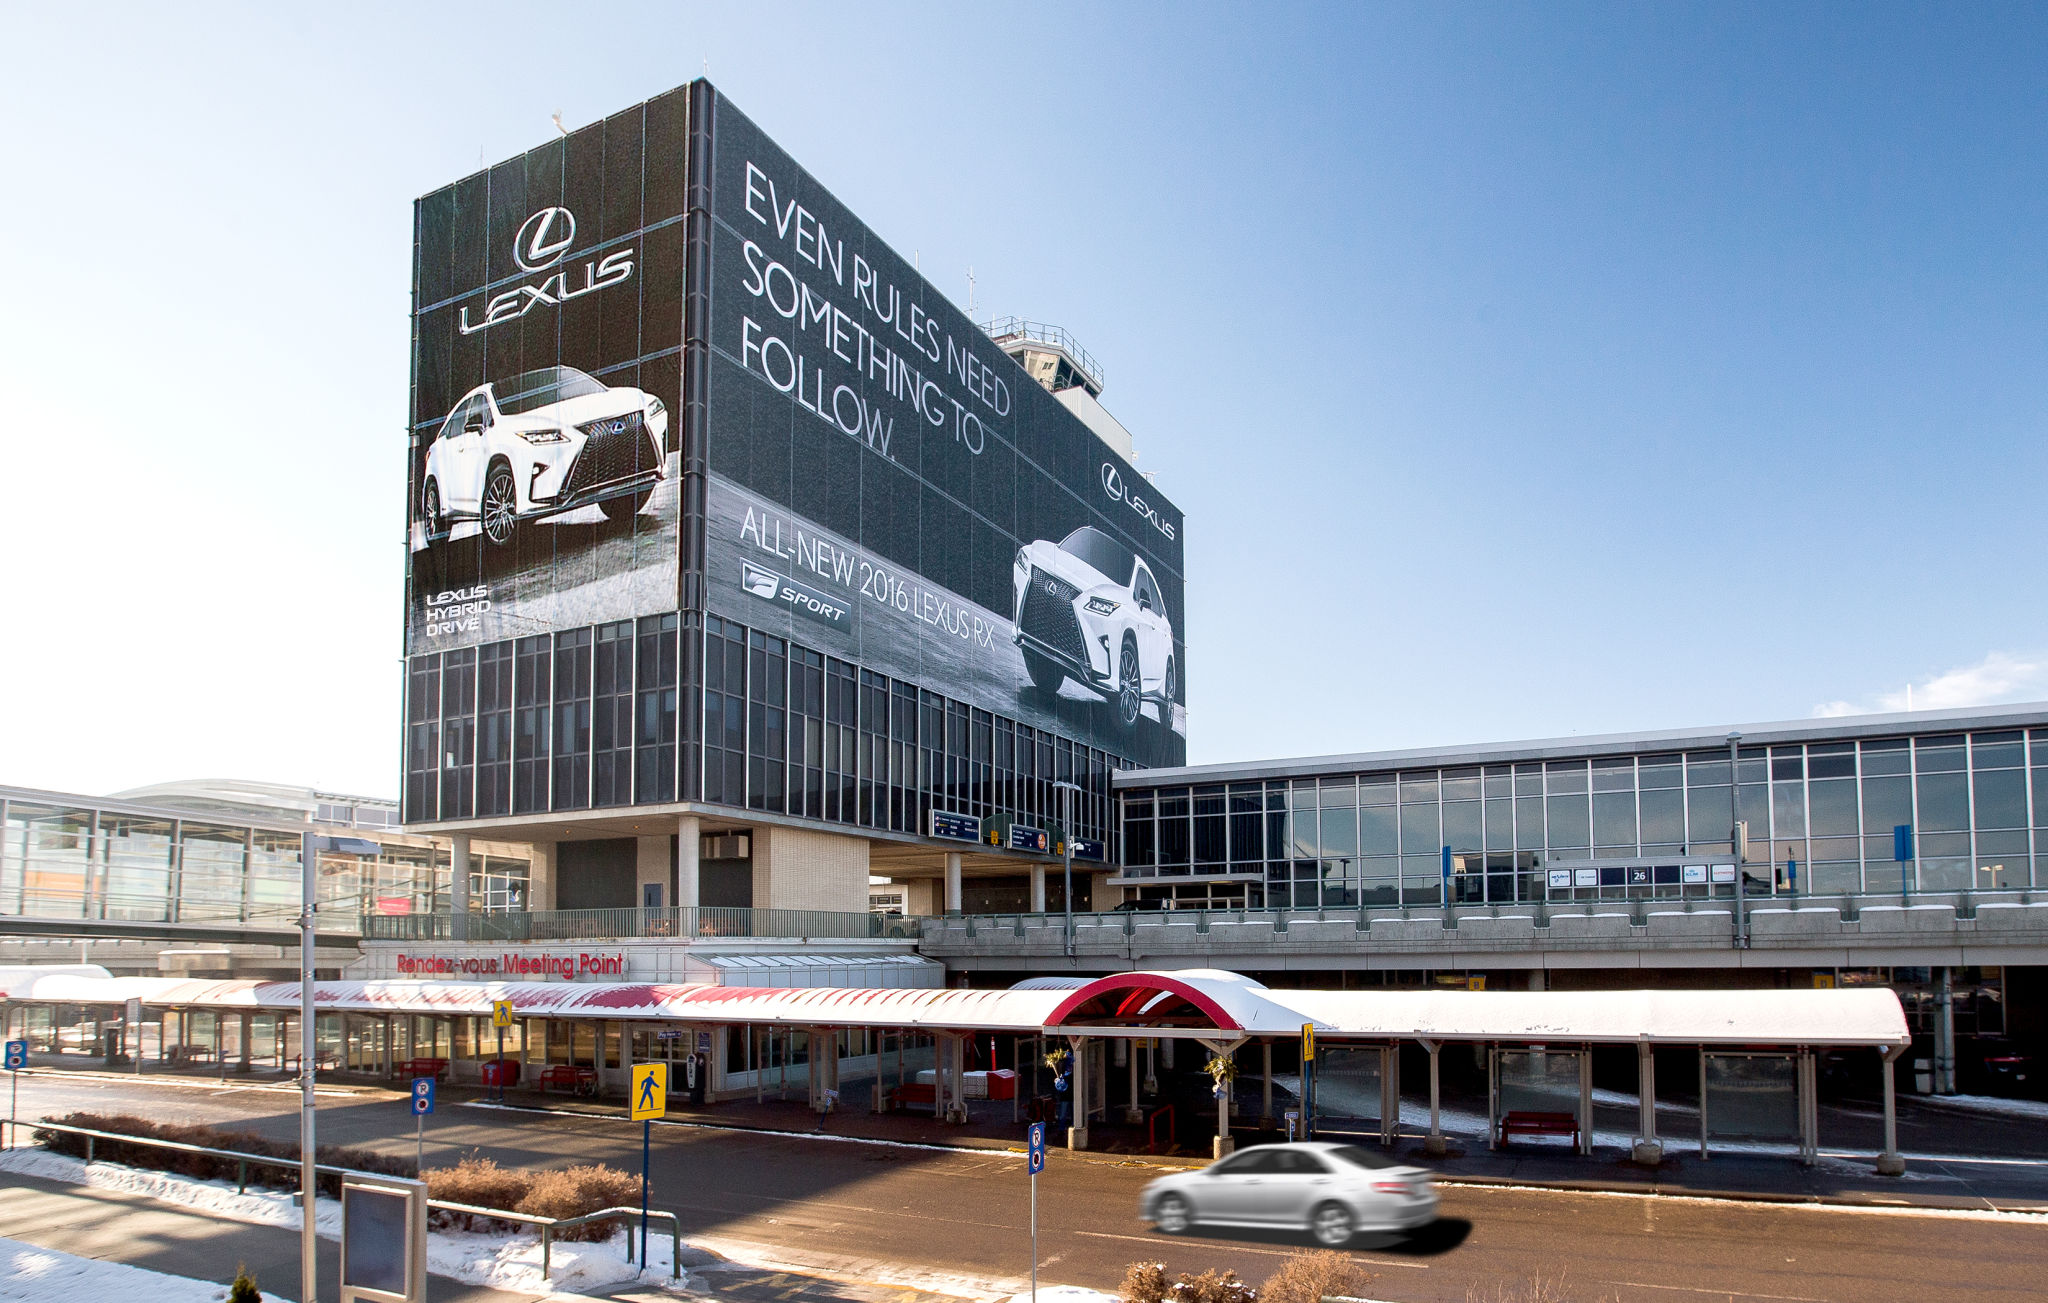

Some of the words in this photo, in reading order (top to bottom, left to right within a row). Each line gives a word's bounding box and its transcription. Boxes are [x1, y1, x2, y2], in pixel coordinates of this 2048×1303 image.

[459, 248, 635, 336] LEXUS
[745, 160, 843, 287] EVEN
[854, 253, 940, 363] RULES
[948, 334, 1010, 417] NEED
[742, 239, 945, 427] SOMETHING
[951, 398, 984, 455] TO
[742, 315, 895, 462] FOLLOW.
[1124, 485, 1175, 541] LEXUS
[426, 584, 489, 606] LEXUS
[740, 506, 856, 587] ALL-NEW
[860, 561, 909, 612] 2016
[914, 586, 970, 640] LEXUS
[974, 615, 996, 652] RX
[426, 600, 491, 622] HYBRID
[426, 617, 481, 637] DRIVE
[780, 587, 847, 622] SPORT
[1633, 871, 1646, 881] 26
[397, 953, 497, 975] Rendez-vous
[503, 953, 574, 980] Meeting
[579, 952, 624, 975] Point
